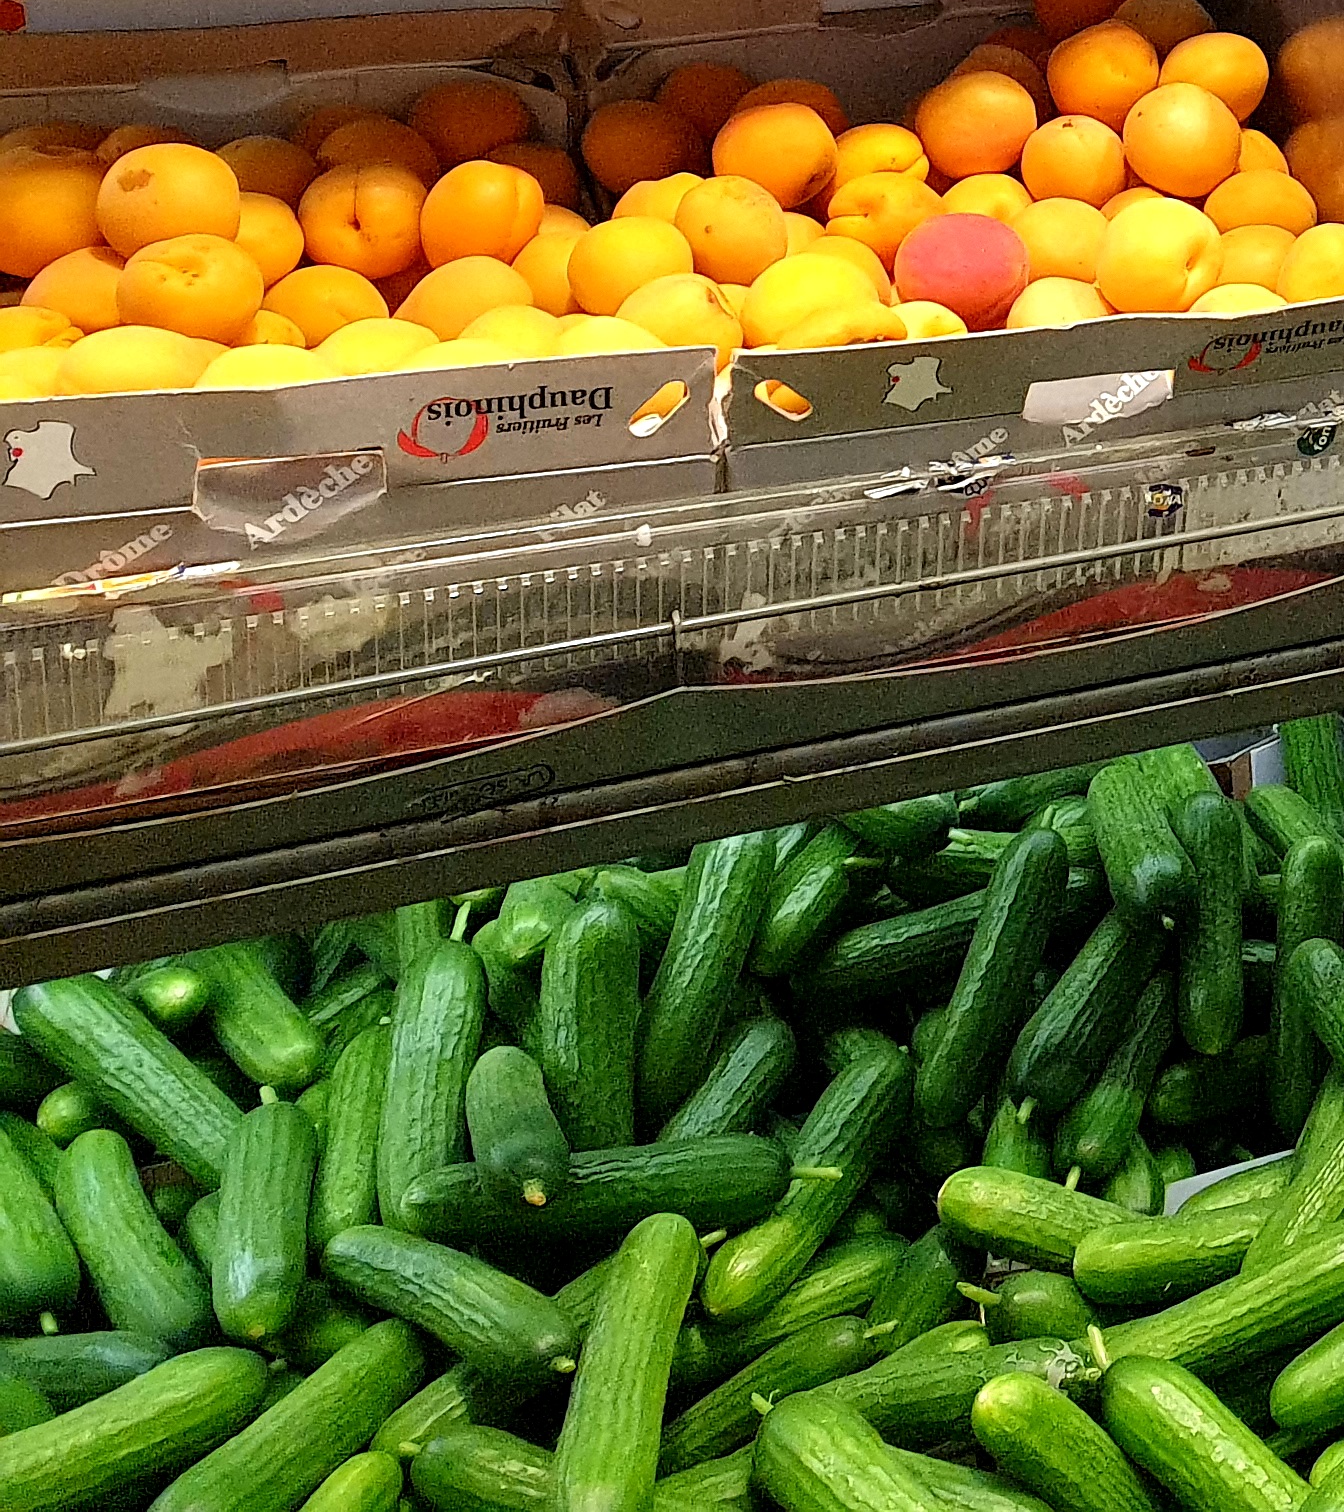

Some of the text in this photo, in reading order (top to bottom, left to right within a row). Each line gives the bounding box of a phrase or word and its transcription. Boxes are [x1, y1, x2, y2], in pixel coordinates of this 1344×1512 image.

[427, 385, 614, 427] Dauphinois
[495, 413, 604, 435] Les Fruitiers
[244, 453, 374, 550] Ardèche
